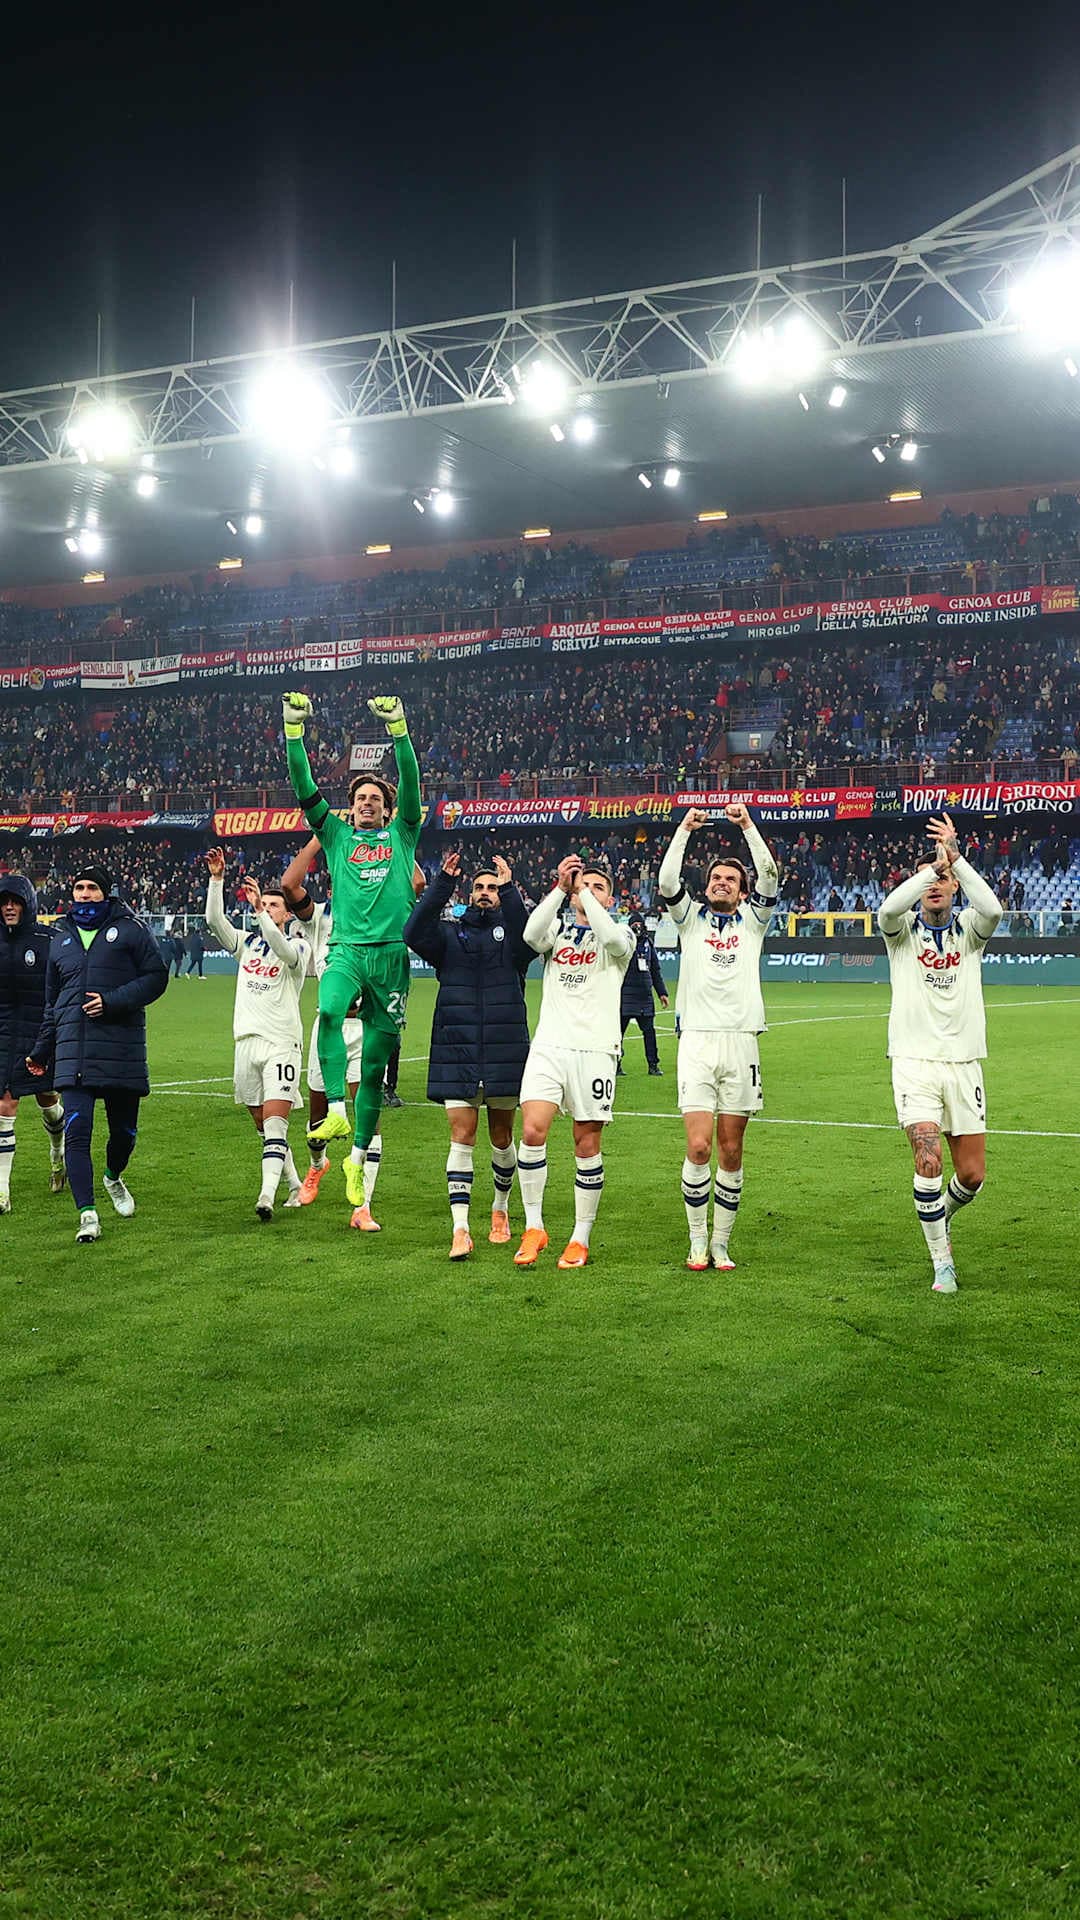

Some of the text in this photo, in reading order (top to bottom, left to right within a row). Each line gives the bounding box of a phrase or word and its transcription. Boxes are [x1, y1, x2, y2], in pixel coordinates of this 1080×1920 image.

[831, 597, 912, 612] GENOA CLUB
[949, 590, 1031, 609] GENOA CLUB
[664, 610, 732, 625] GENOA CLUB
[739, 606, 814, 623] GENOA CLUB
[825, 604, 930, 621] ISTITUTO ITALIANO
[937, 604, 1038, 624] GRIFONE INSIDE
[604, 620, 662, 631] GENOA CLUB
[822, 613, 929, 631] DELLA SALDATURA
[748, 623, 801, 638] MIROGLIO
[394, 638, 415, 647] CLUB
[492, 636, 541, 650] EUSEBIO
[603, 636, 661, 646] ENTRACQUE
[247, 648, 304, 664] GENOA CLUB
[306, 644, 333, 654] GENOA
[437, 643, 482, 660] LIGURIA
[140, 655, 179, 672] NEW YORK
[182, 657, 206, 665] GENOA
[367, 651, 415, 664] REGIONE
[83, 662, 123, 674] GENOA CLUB
[181, 670, 196, 678] SAN
[246, 663, 285, 676] RAPALLO
[53, 677, 77, 688] UNICA
[677, 793, 754, 804] GENOA CLUB GAVI
[757, 792, 837, 803] GENOA CLUB
[846, 790, 897, 799] GENOA CLUB
[1002, 784, 1076, 801] GRIFONI
[466, 799, 562, 813] ASSOCIAZIONE
[588, 800, 632, 819] Little
[634, 797, 673, 816] Club
[1003, 798, 1073, 815] TORINO
[462, 812, 554, 826] CLUB GENOANI
[760, 809, 830, 820] VALBORMIDA
[214, 811, 268, 836] FIGGI
[348, 843, 392, 864] Lete
[553, 946, 597, 966] Lete
[917, 949, 961, 970] Lete
[242, 958, 280, 978] Lete
[276, 1064, 295, 1082] 10
[592, 1078, 613, 1100] 90
